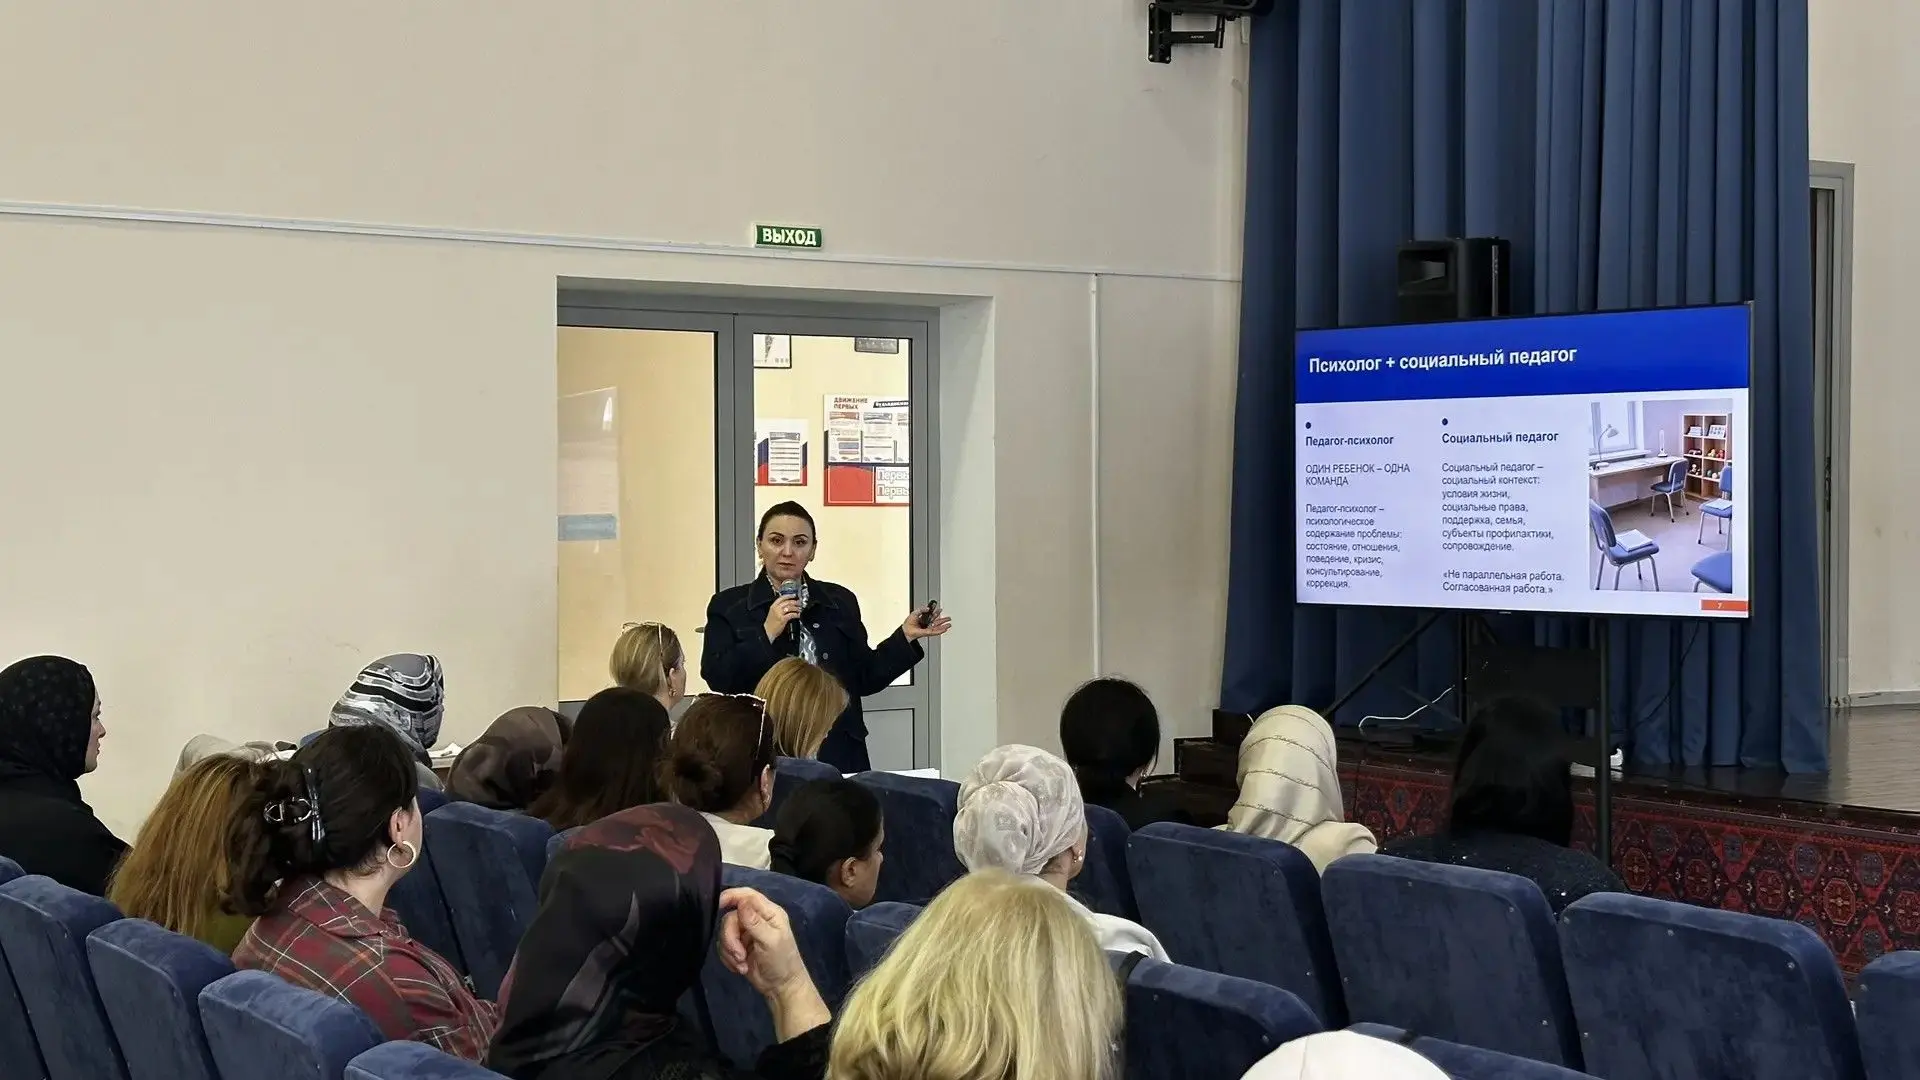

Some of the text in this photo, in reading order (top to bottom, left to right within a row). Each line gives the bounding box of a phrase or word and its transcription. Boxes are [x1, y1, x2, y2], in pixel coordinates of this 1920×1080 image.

[762, 228, 817, 246] ВЫХОД
[1309, 348, 1577, 373] Психолог + социальный педагог
[1305, 436, 1394, 447] Педагог-психолог
[1442, 432, 1559, 444] Социальный педагог
[1305, 464, 1331, 475] ОДИН
[1332, 464, 1375, 473] РЕБЕНОК
[1384, 463, 1411, 474] ОДНА
[1442, 462, 1498, 473] Социальный
[1500, 463, 1535, 473] педагог
[1305, 476, 1349, 486] КОМАНДА
[1442, 475, 1540, 485] социальный контекст:
[1442, 490, 1511, 499] условия жизни,
[1305, 504, 1377, 513] Педагог-психолог
[1442, 503, 1528, 513] социальные права,
[1305, 517, 1374, 526] психологическое
[1442, 516, 1526, 526] поддержка, семья,
[1305, 529, 1402, 540] содержание проблемы:
[1442, 528, 1554, 540] субъекты профилактики,
[1305, 542, 1401, 552] состояние, отношения,
[1442, 542, 1515, 552] сопровождение.
[1305, 555, 1384, 565] поведение, кризис,
[1306, 567, 1383, 577] консультирование,
[1443, 570, 1460, 579] «Не
[1462, 571, 1527, 581] параллельная
[1306, 579, 1350, 589] коррекция.
[1442, 581, 1511, 593] Согласованная
